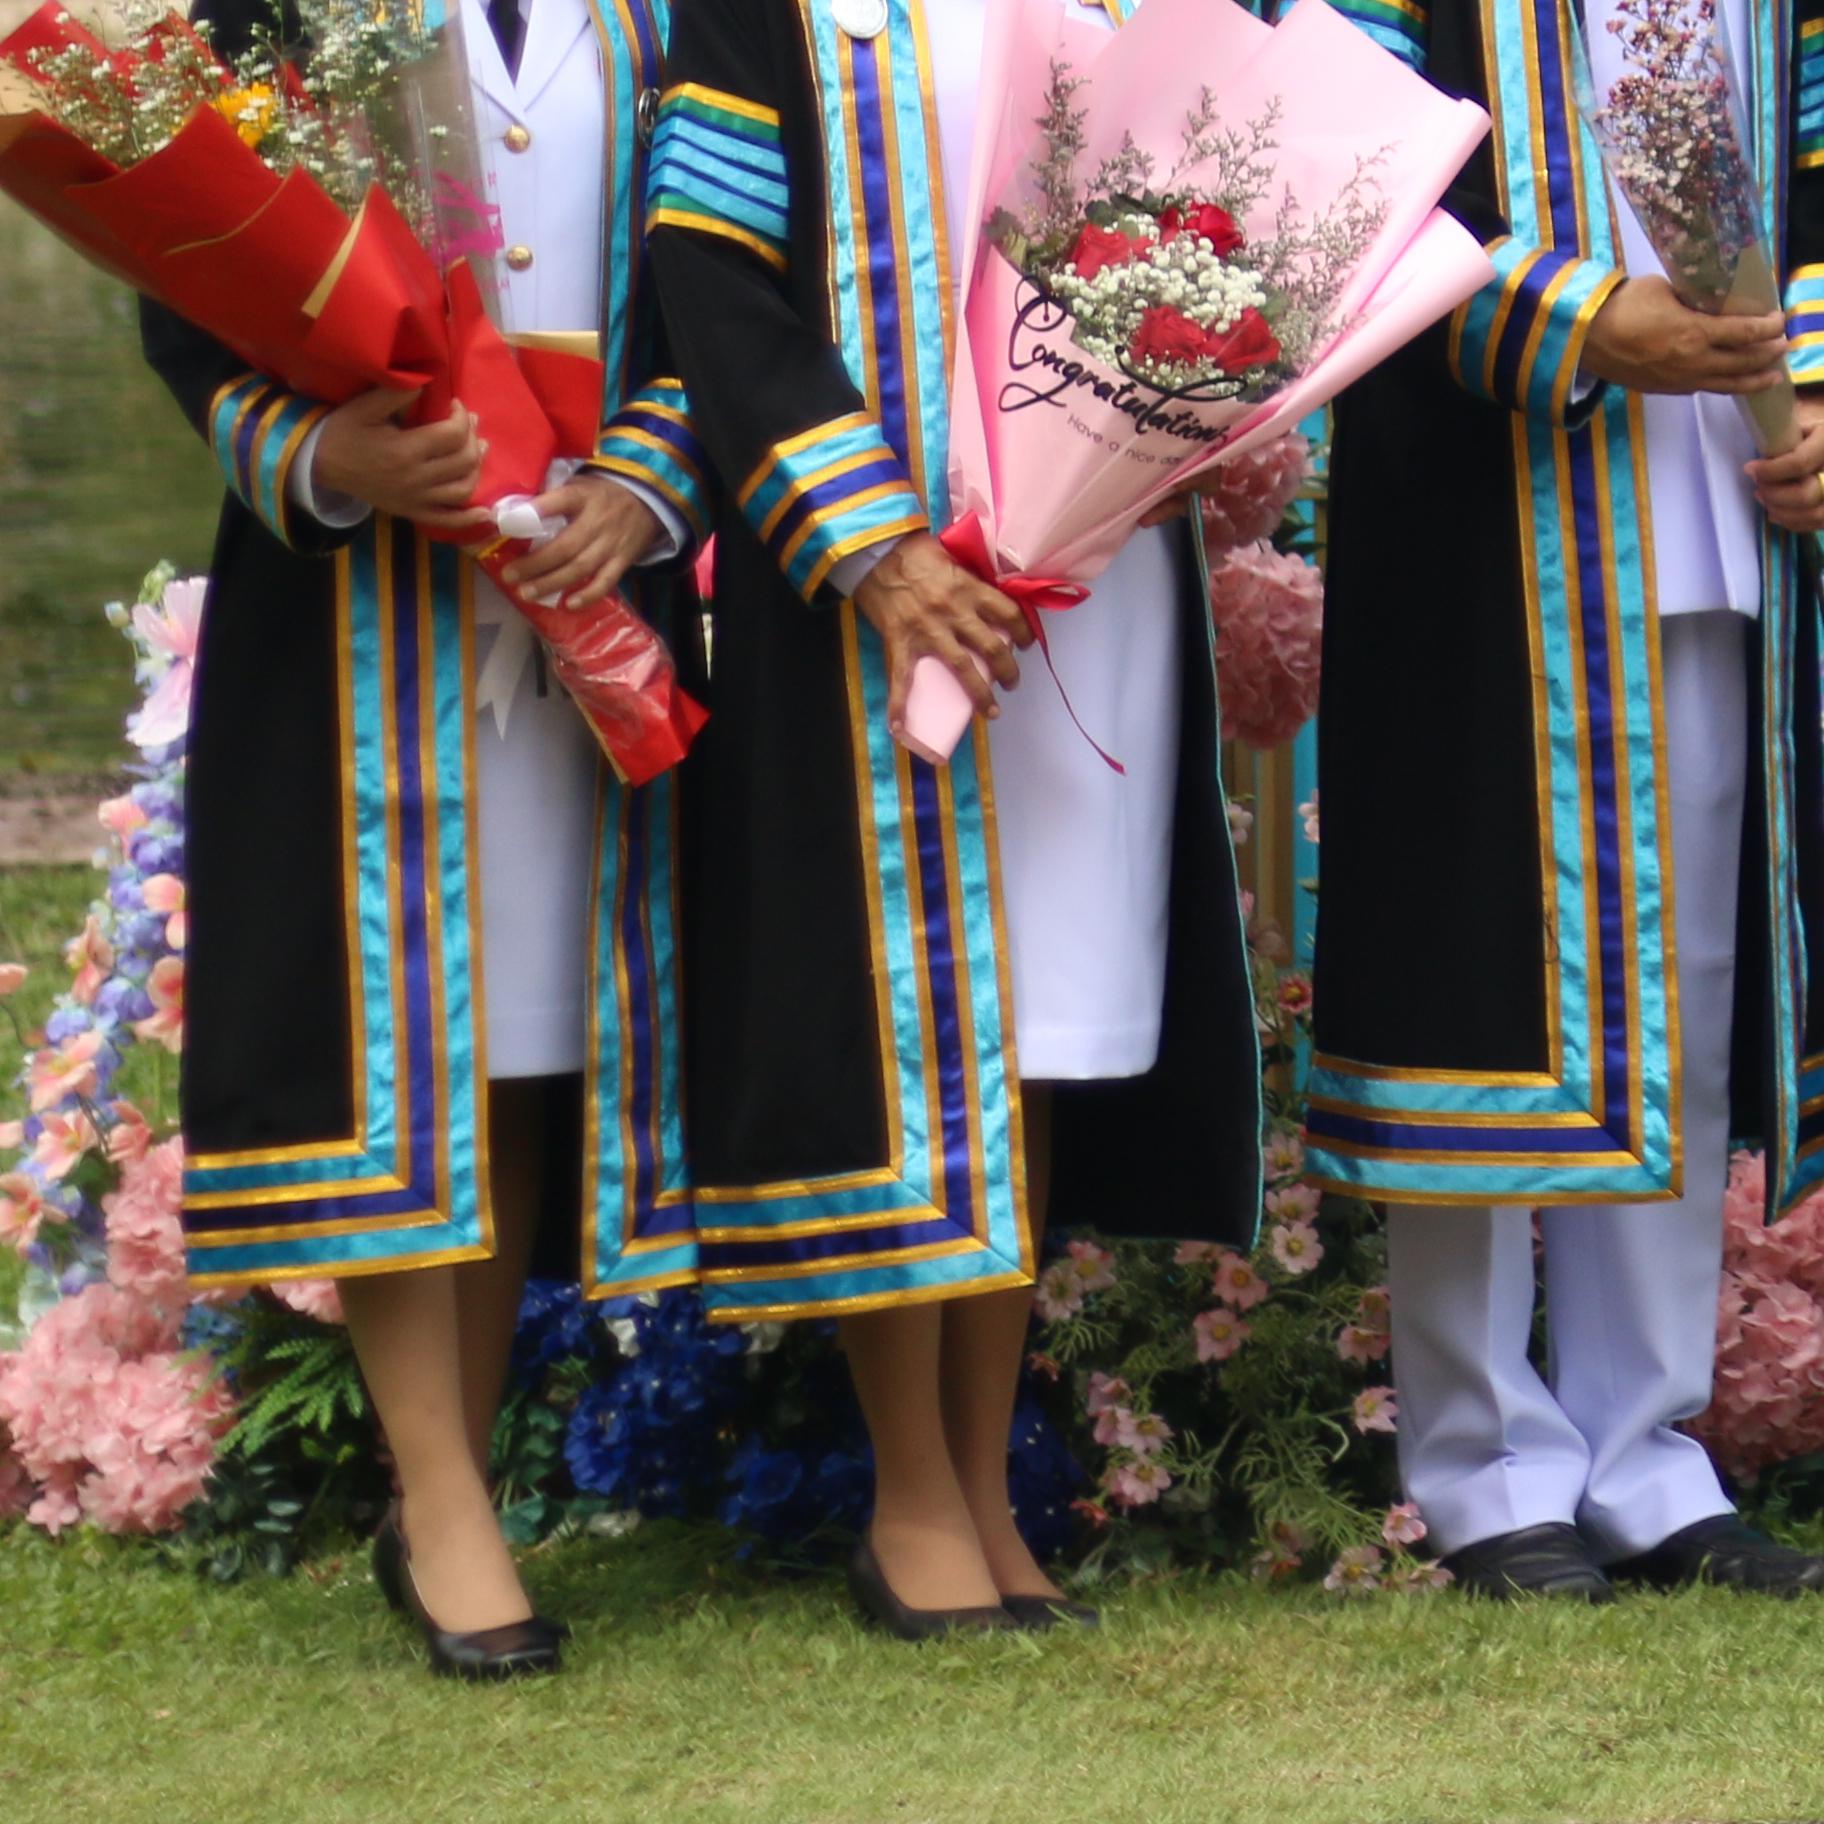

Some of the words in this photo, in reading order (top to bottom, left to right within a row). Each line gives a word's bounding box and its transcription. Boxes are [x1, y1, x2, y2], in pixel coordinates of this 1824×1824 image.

[1066, 413, 1104, 445] Have
[1108, 441, 1120, 452] a
[1124, 447, 1156, 465] nice
